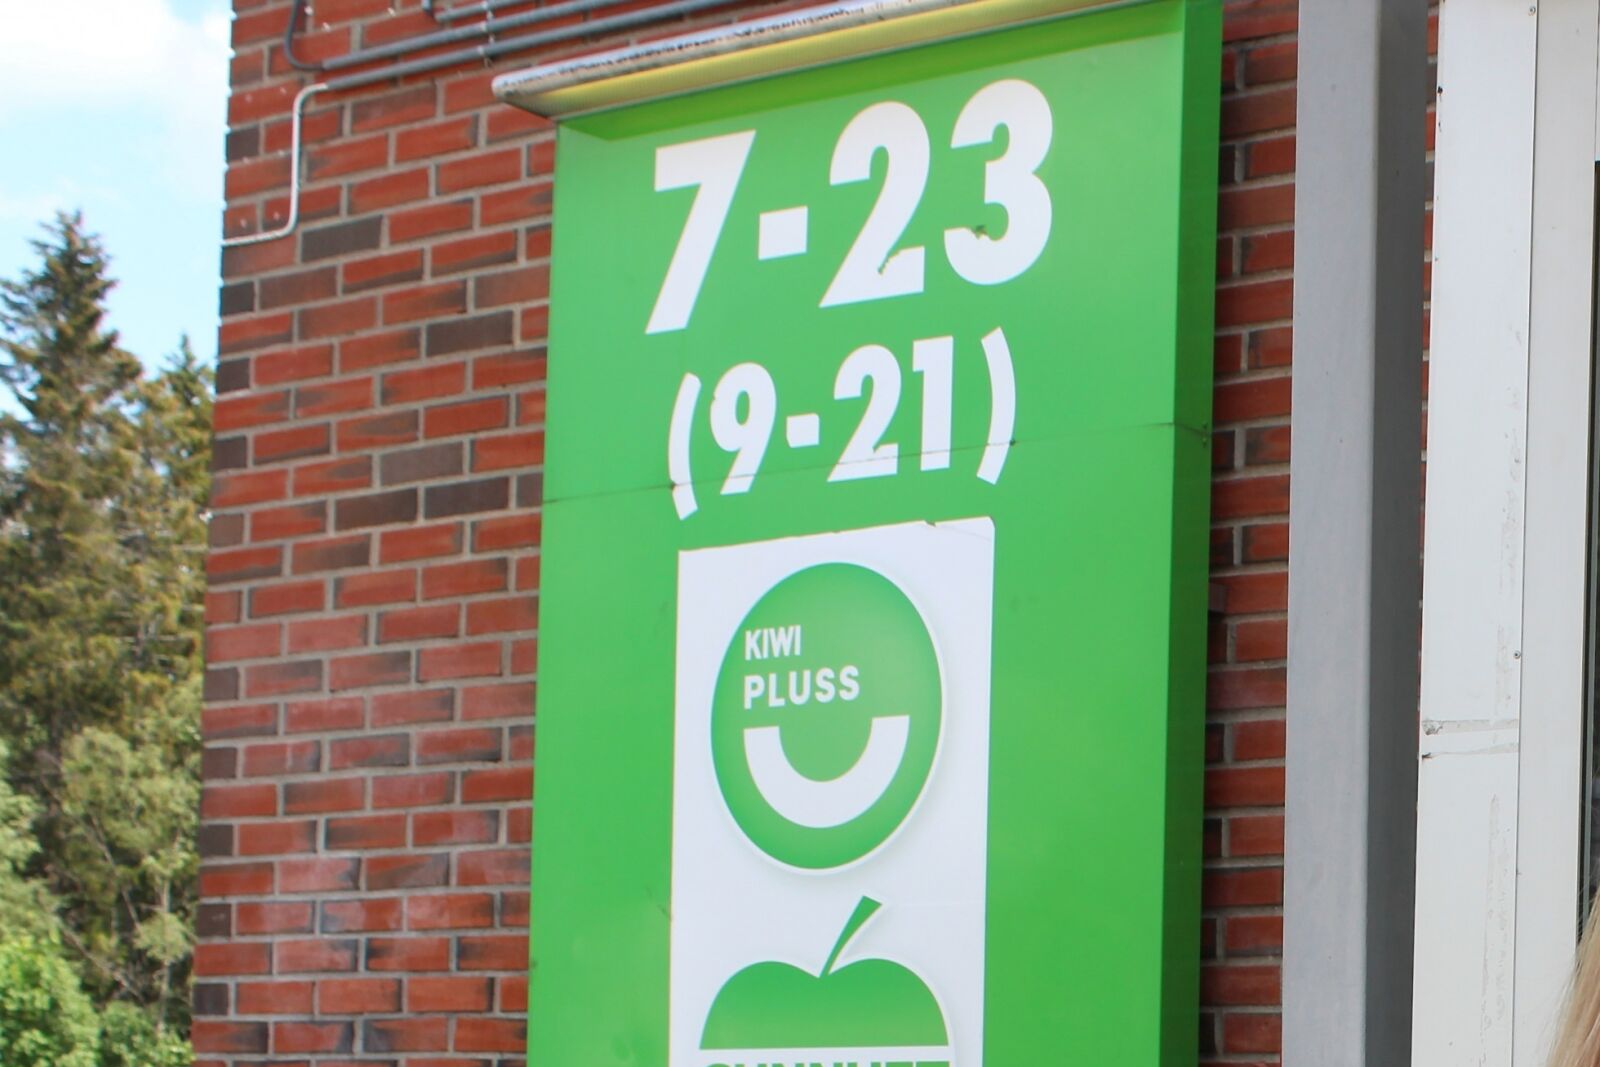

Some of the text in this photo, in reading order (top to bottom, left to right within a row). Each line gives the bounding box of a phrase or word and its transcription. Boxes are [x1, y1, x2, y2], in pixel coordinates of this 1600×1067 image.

[668, 326, 1016, 520] (9-21)
[744, 625, 802, 661] KIWI
[744, 665, 860, 710] PLUSS
